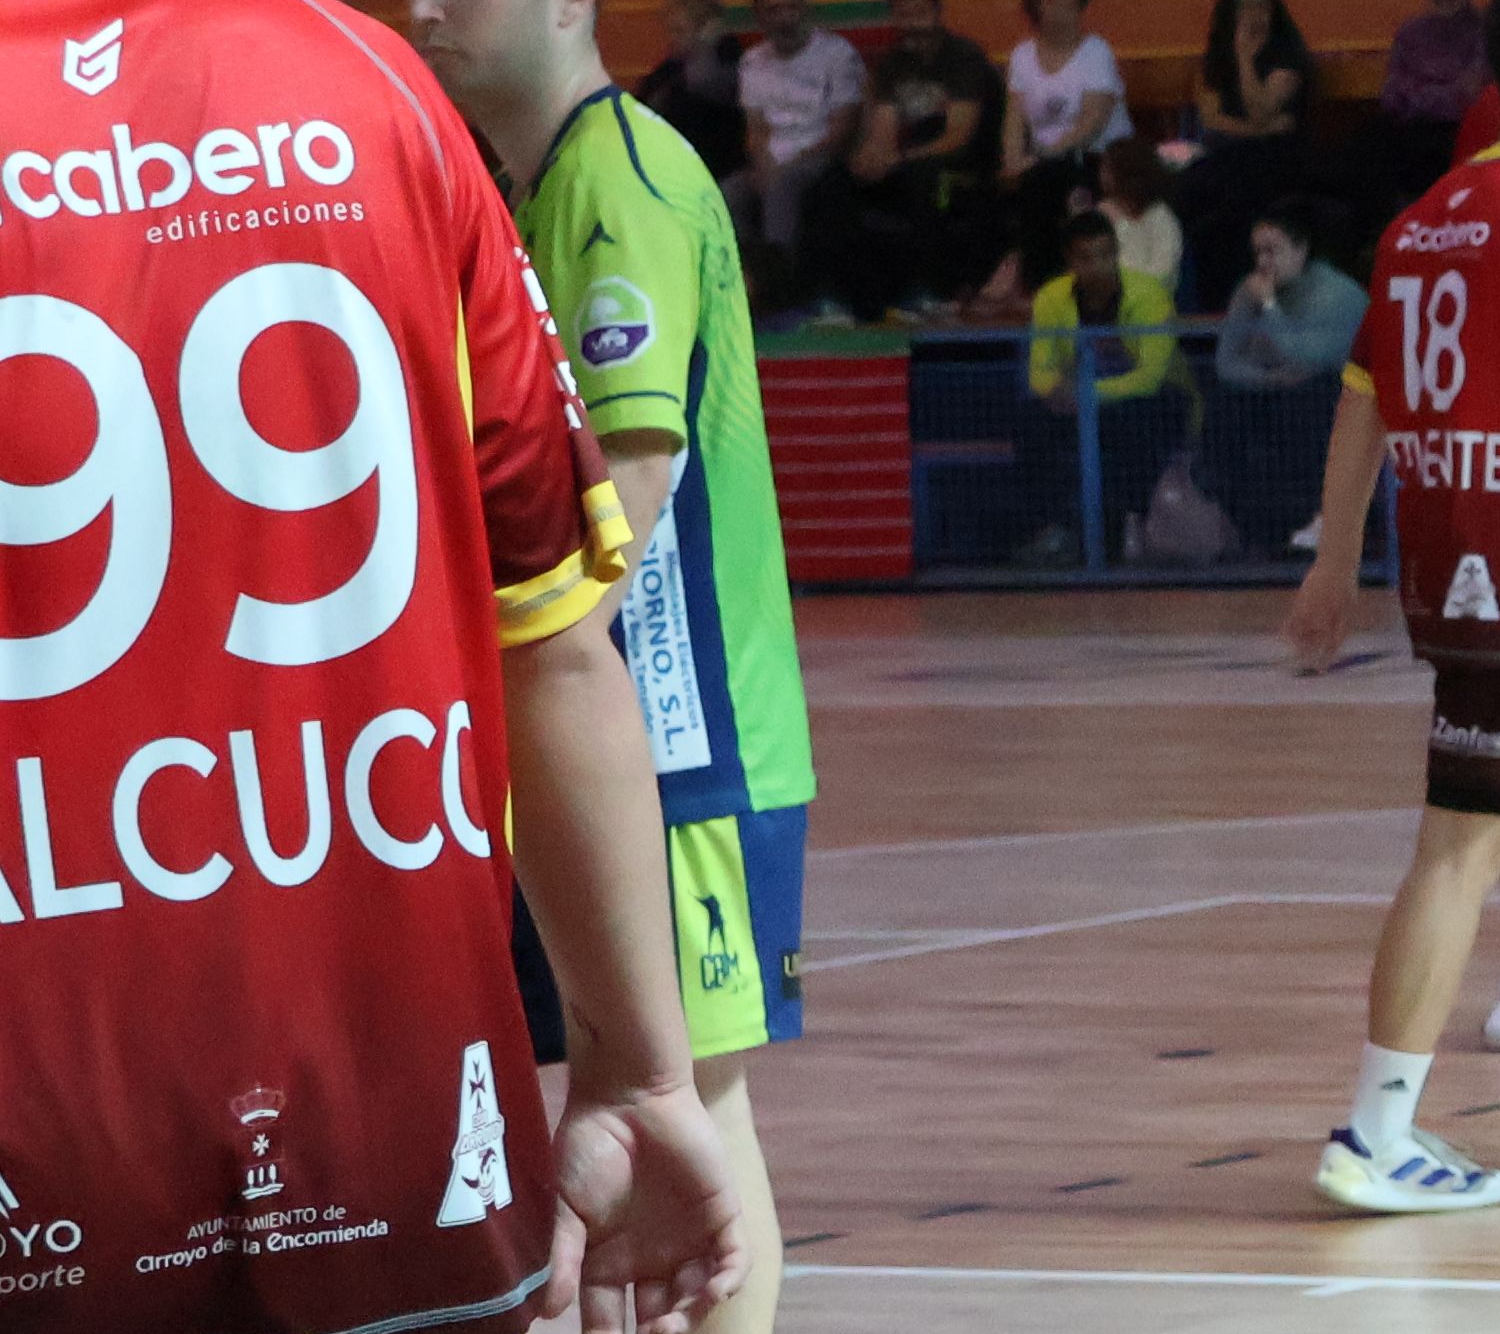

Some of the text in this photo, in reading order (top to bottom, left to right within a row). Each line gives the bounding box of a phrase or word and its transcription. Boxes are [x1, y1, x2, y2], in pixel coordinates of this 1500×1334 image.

[2, 120, 355, 219] cabero
[146, 200, 364, 243] edificaciones
[1389, 269, 1468, 412] 18
[0, 261, 418, 701] 99
[136, 1246, 207, 1274] arroyo
[212, 1235, 238, 1255] de
[242, 1239, 261, 1255] la
[187, 1205, 347, 1240] AYUNTAMIENTO de
